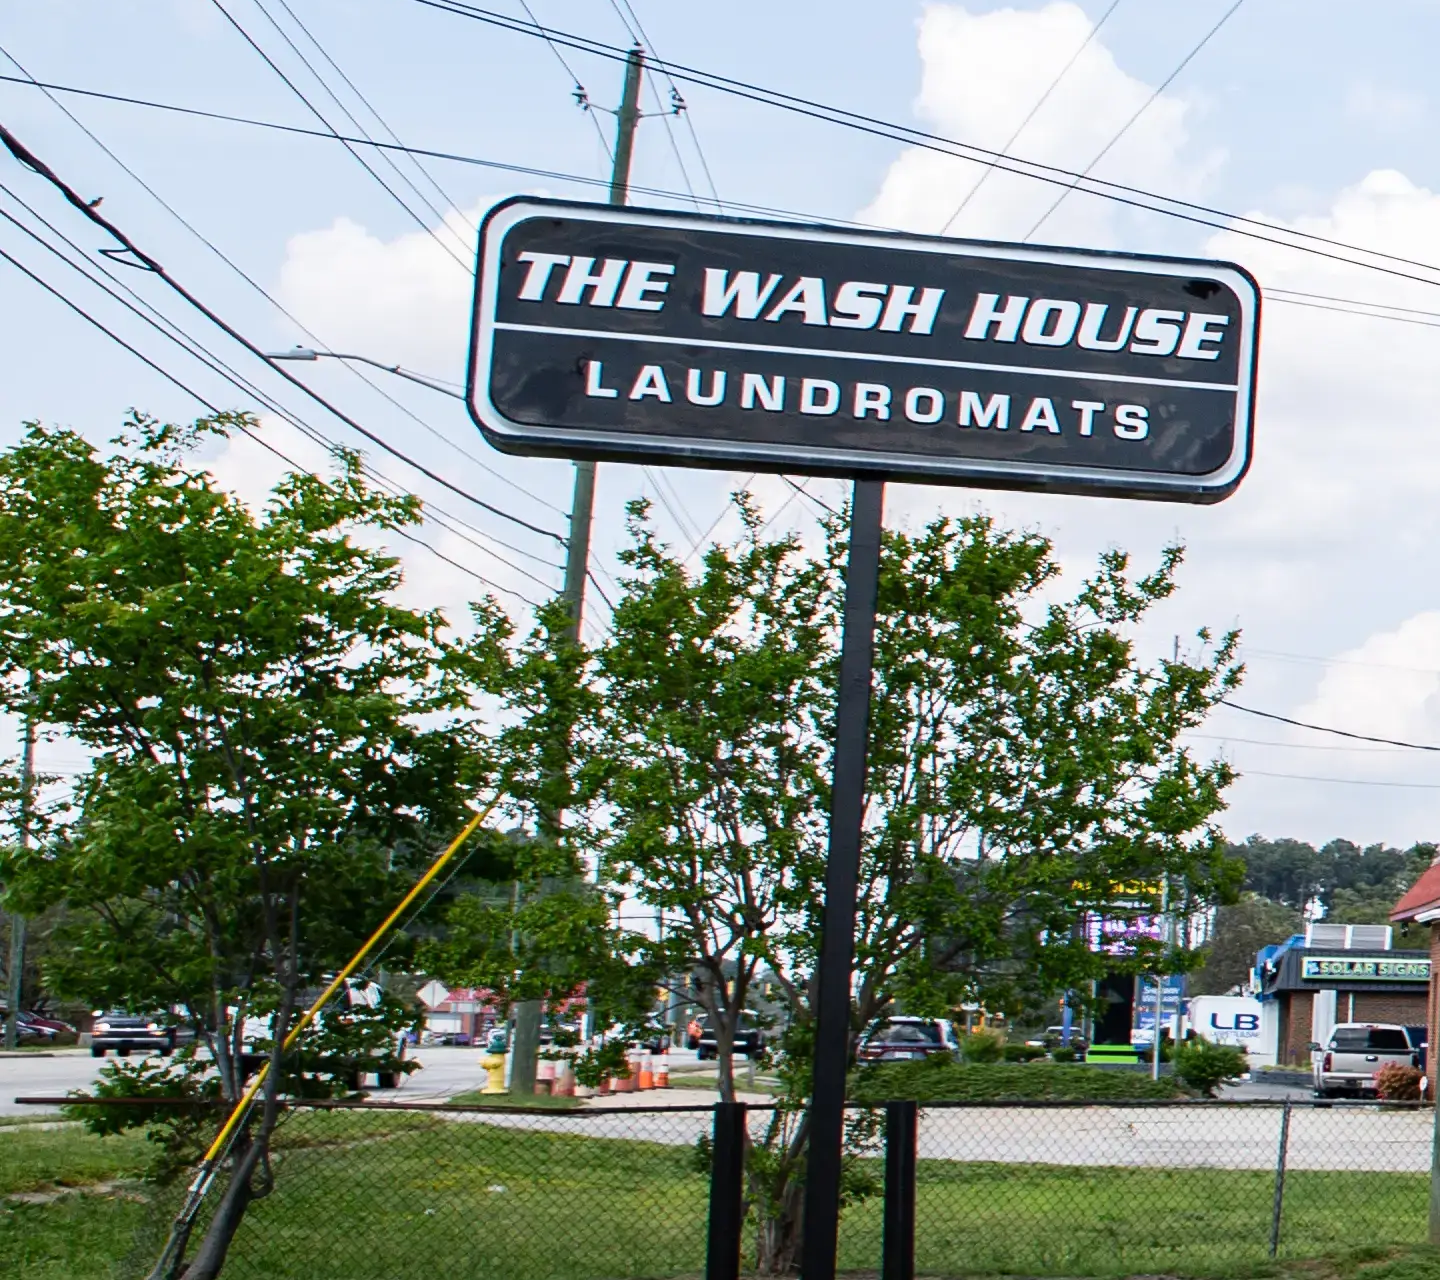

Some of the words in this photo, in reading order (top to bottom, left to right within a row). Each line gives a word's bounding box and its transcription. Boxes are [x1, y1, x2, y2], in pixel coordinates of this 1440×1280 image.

[517, 251, 675, 311] THE
[702, 268, 946, 336] WASH
[963, 293, 1229, 360] HOUSE
[585, 360, 1150, 440] LAUNDROMATS
[1319, 961, 1376, 976] SOLAR
[1378, 963, 1429, 977] SIGNS
[1210, 1012, 1260, 1031] LB
